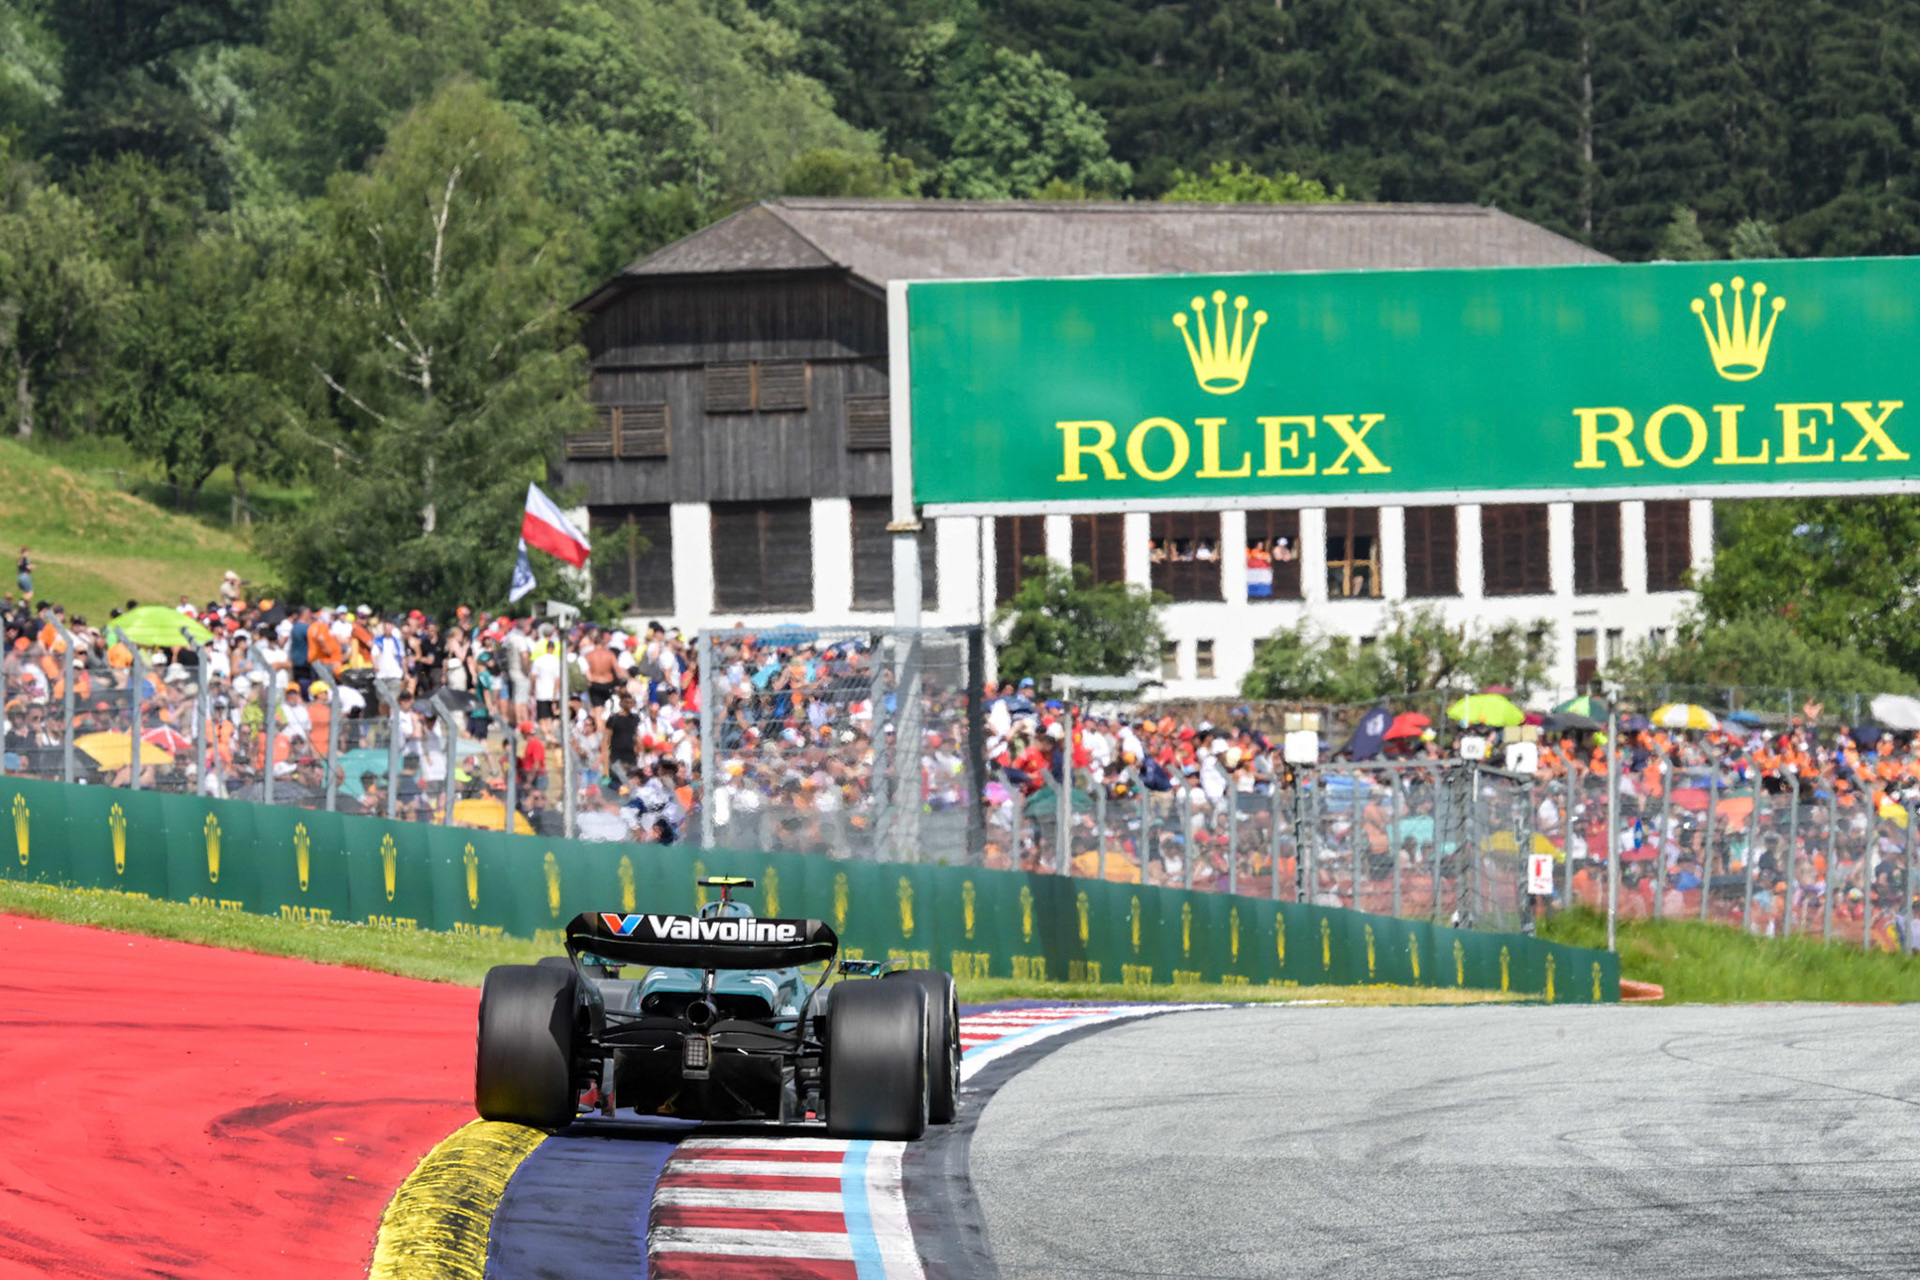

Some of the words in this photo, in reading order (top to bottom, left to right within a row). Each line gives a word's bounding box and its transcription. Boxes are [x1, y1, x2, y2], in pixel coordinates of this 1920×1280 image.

[1055, 413, 1391, 482] ROLEX
[1572, 400, 1910, 468] ROLEX
[648, 915, 797, 942] Valvoline
